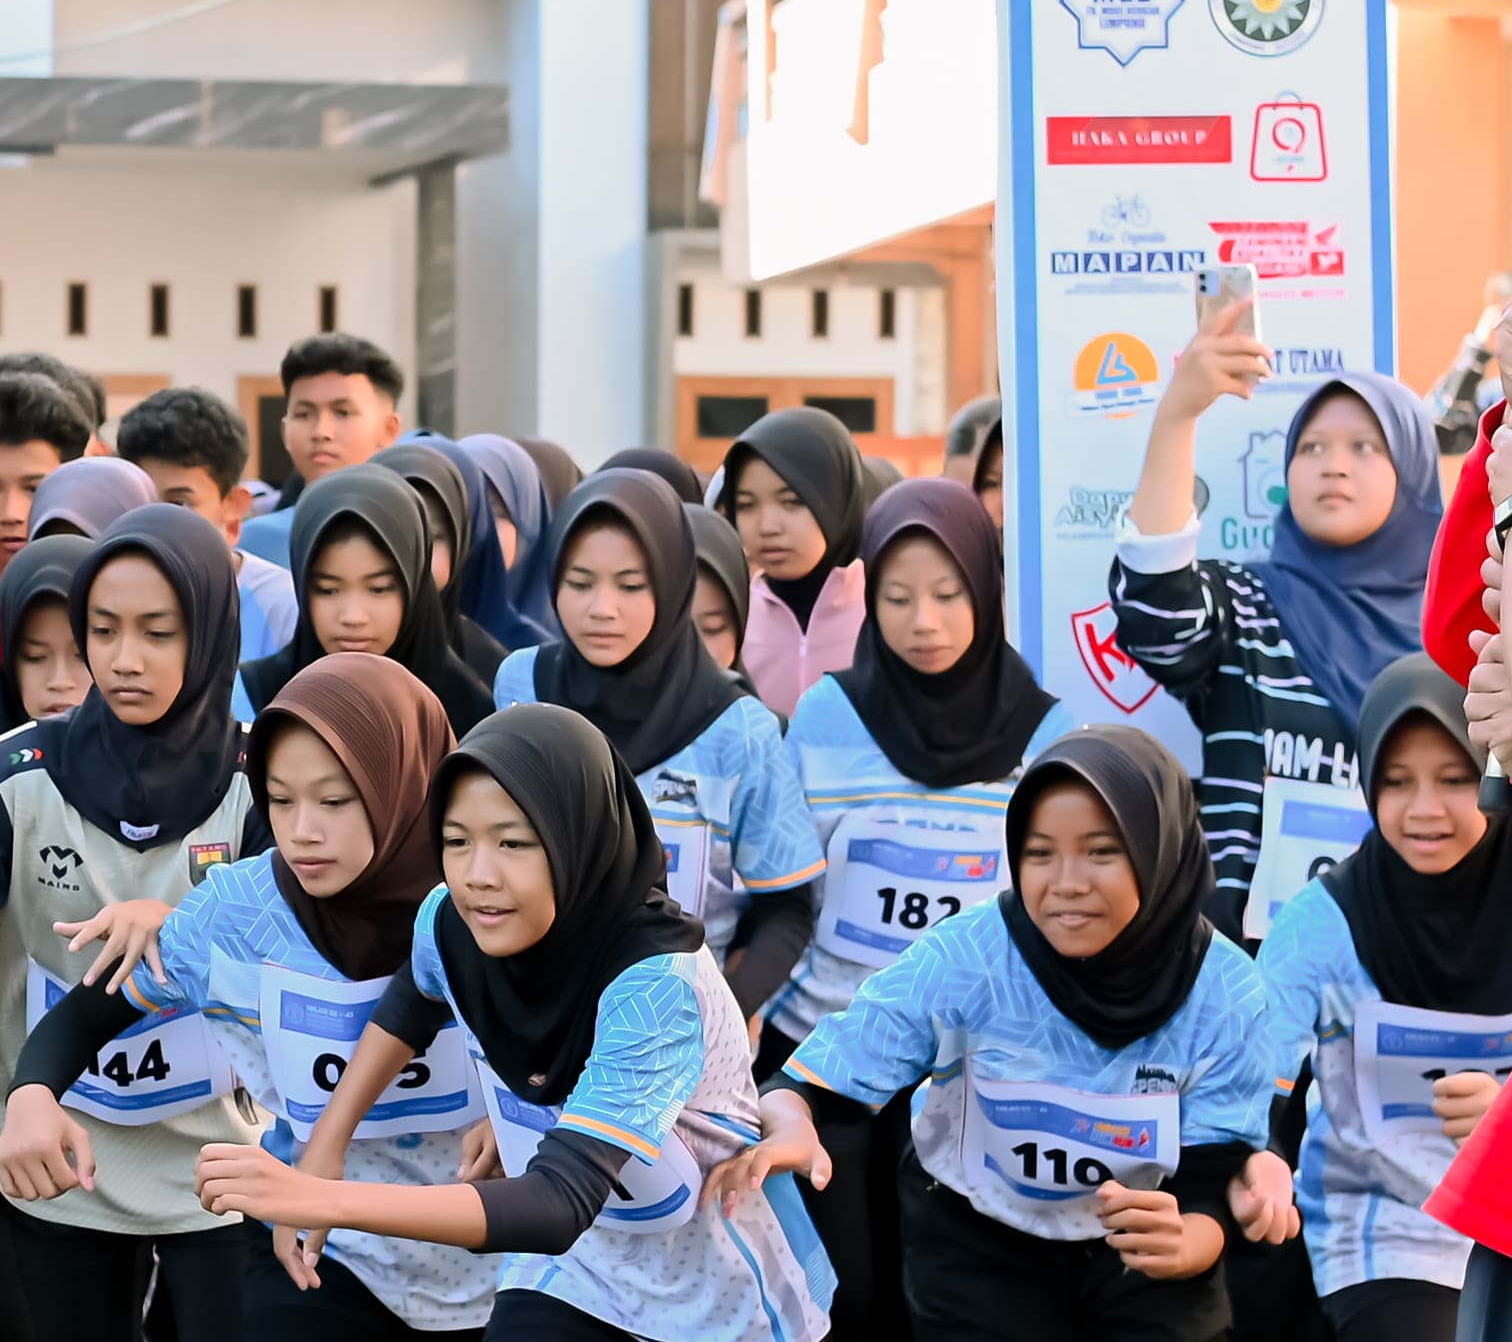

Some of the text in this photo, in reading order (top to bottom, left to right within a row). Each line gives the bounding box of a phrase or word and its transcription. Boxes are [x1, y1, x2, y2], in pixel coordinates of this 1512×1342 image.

[1135, 130, 1207, 146] GROUP
[1053, 251, 1205, 274] MAPAN
[87, 1038, 171, 1087] 44
